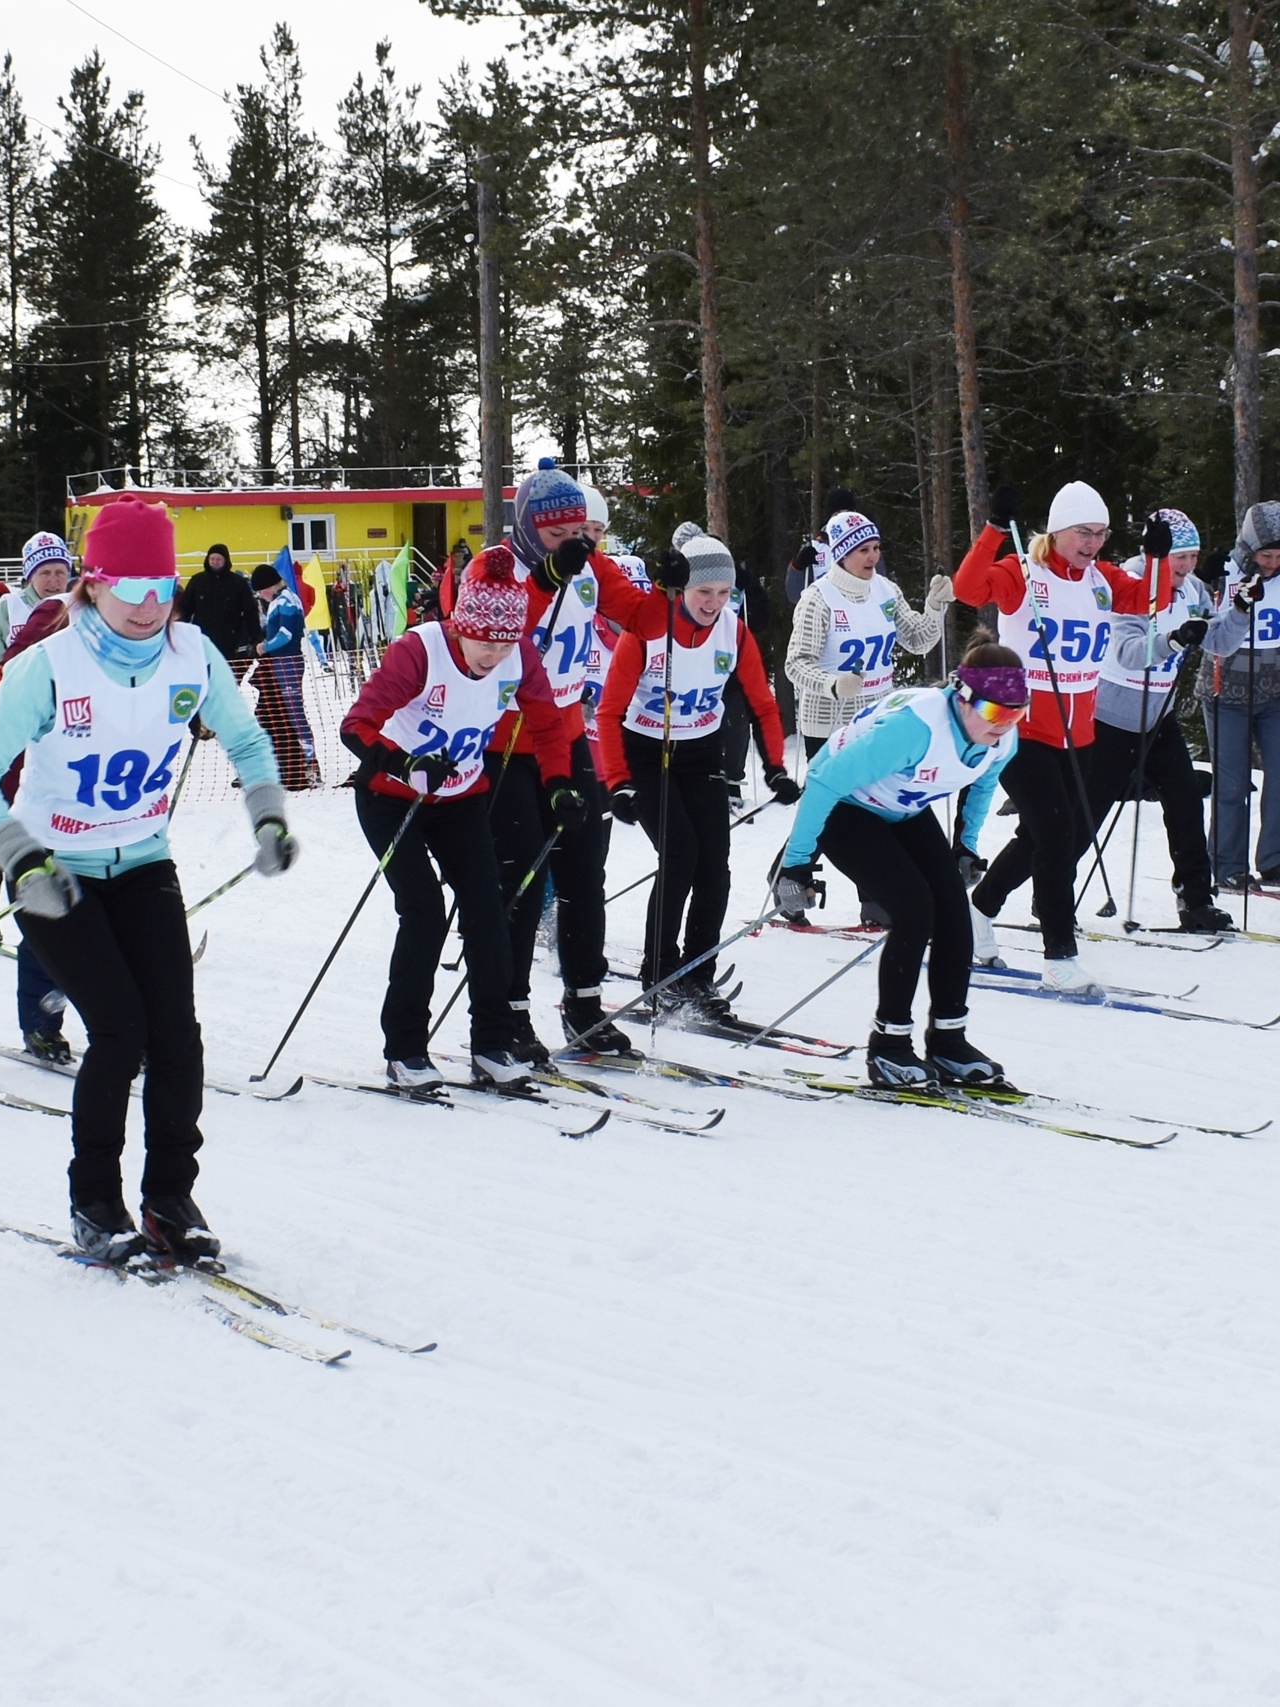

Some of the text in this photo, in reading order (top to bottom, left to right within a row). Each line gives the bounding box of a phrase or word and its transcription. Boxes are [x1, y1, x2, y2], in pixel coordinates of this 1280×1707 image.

[529, 621, 593, 675] 214
[837, 631, 896, 672] 270
[1028, 616, 1111, 663] 256
[63, 696, 91, 728] LUK
[644, 684, 723, 716] 215
